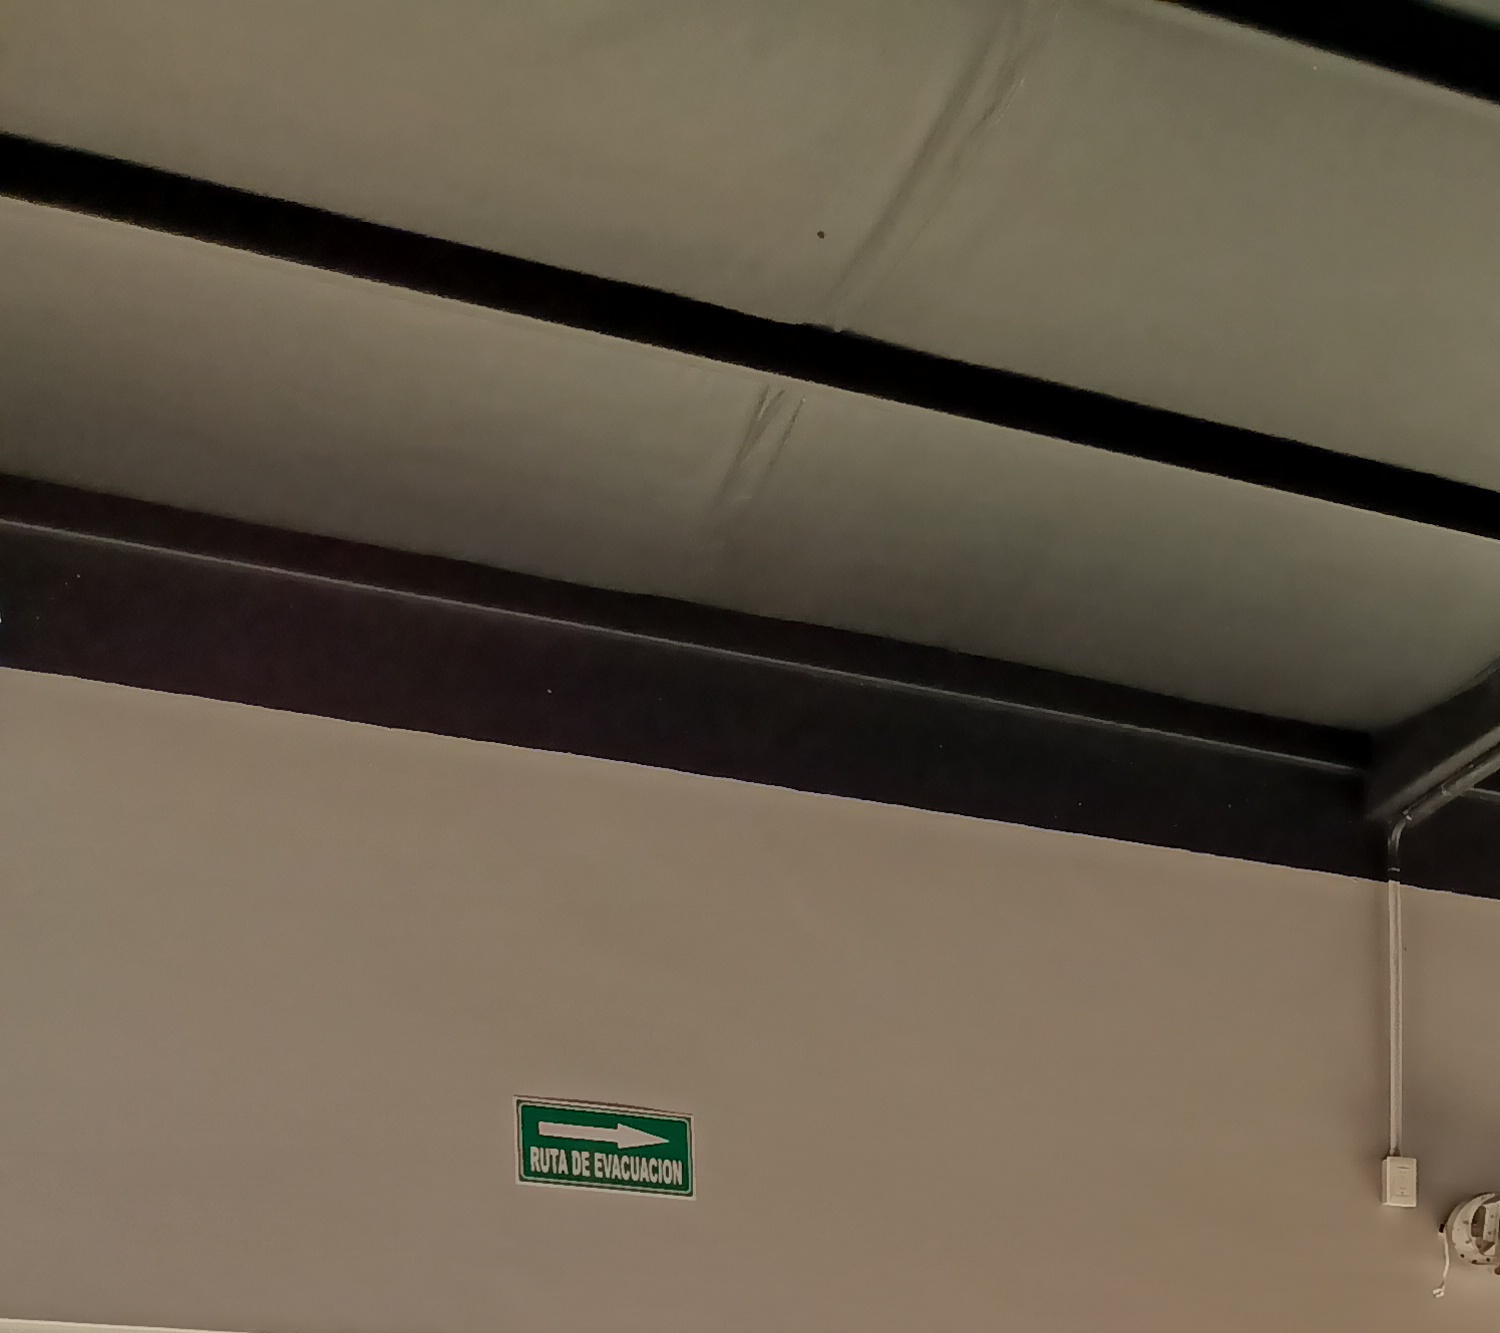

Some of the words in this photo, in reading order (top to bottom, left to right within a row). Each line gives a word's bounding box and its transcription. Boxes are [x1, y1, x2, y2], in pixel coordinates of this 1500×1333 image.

[530, 1146, 569, 1175] RUTA
[571, 1150, 591, 1178] DE
[594, 1152, 683, 1185] EVACUACION
